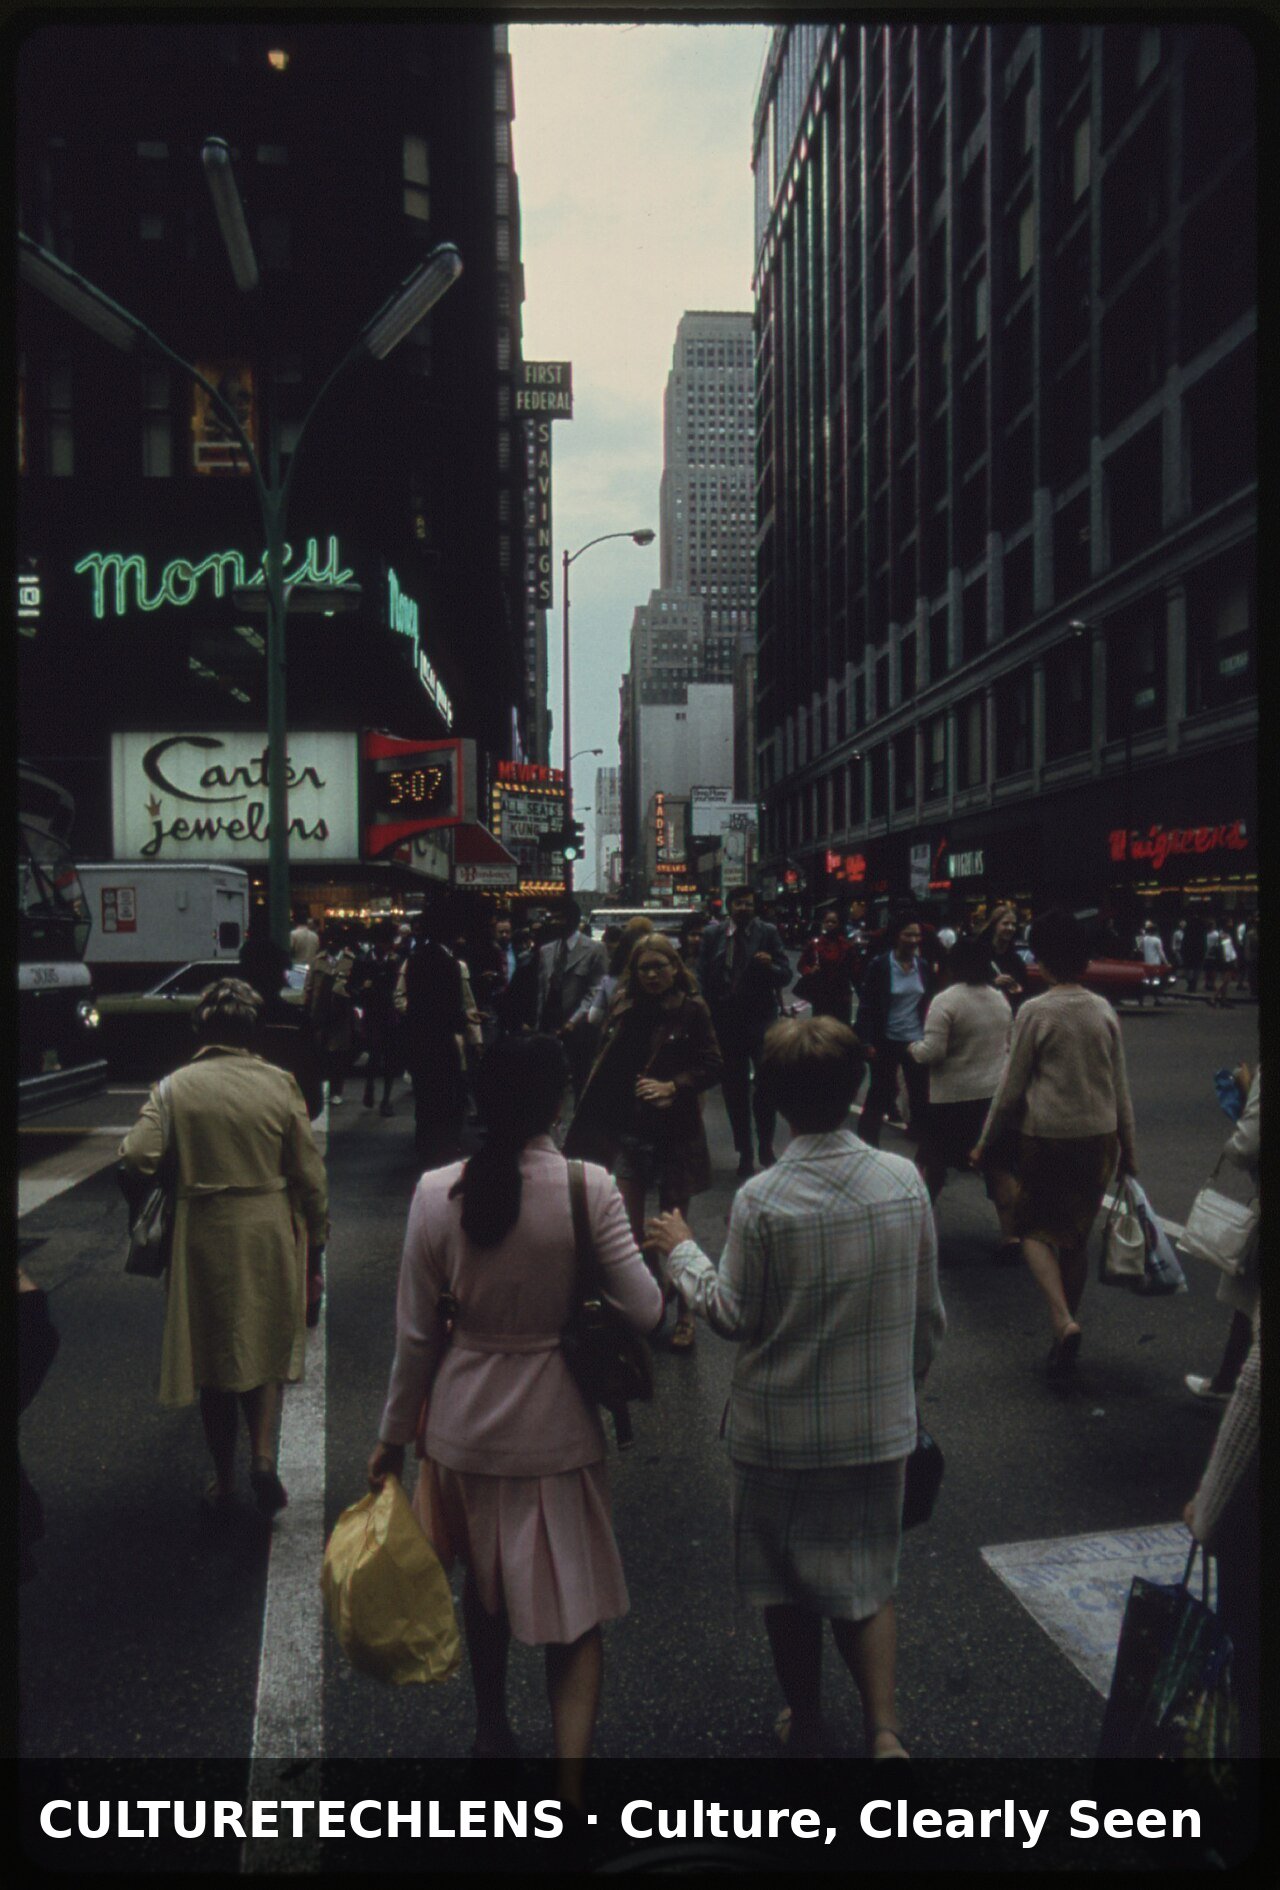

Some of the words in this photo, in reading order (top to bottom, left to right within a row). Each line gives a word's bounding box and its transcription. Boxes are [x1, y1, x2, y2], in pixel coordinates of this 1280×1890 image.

[524, 364, 562, 384] FIRST
[516, 390, 571, 411] FEDERAL
[537, 423, 550, 601] SAVINGS
[390, 767, 442, 804] 5:07
[140, 802, 329, 855] jewelrs
